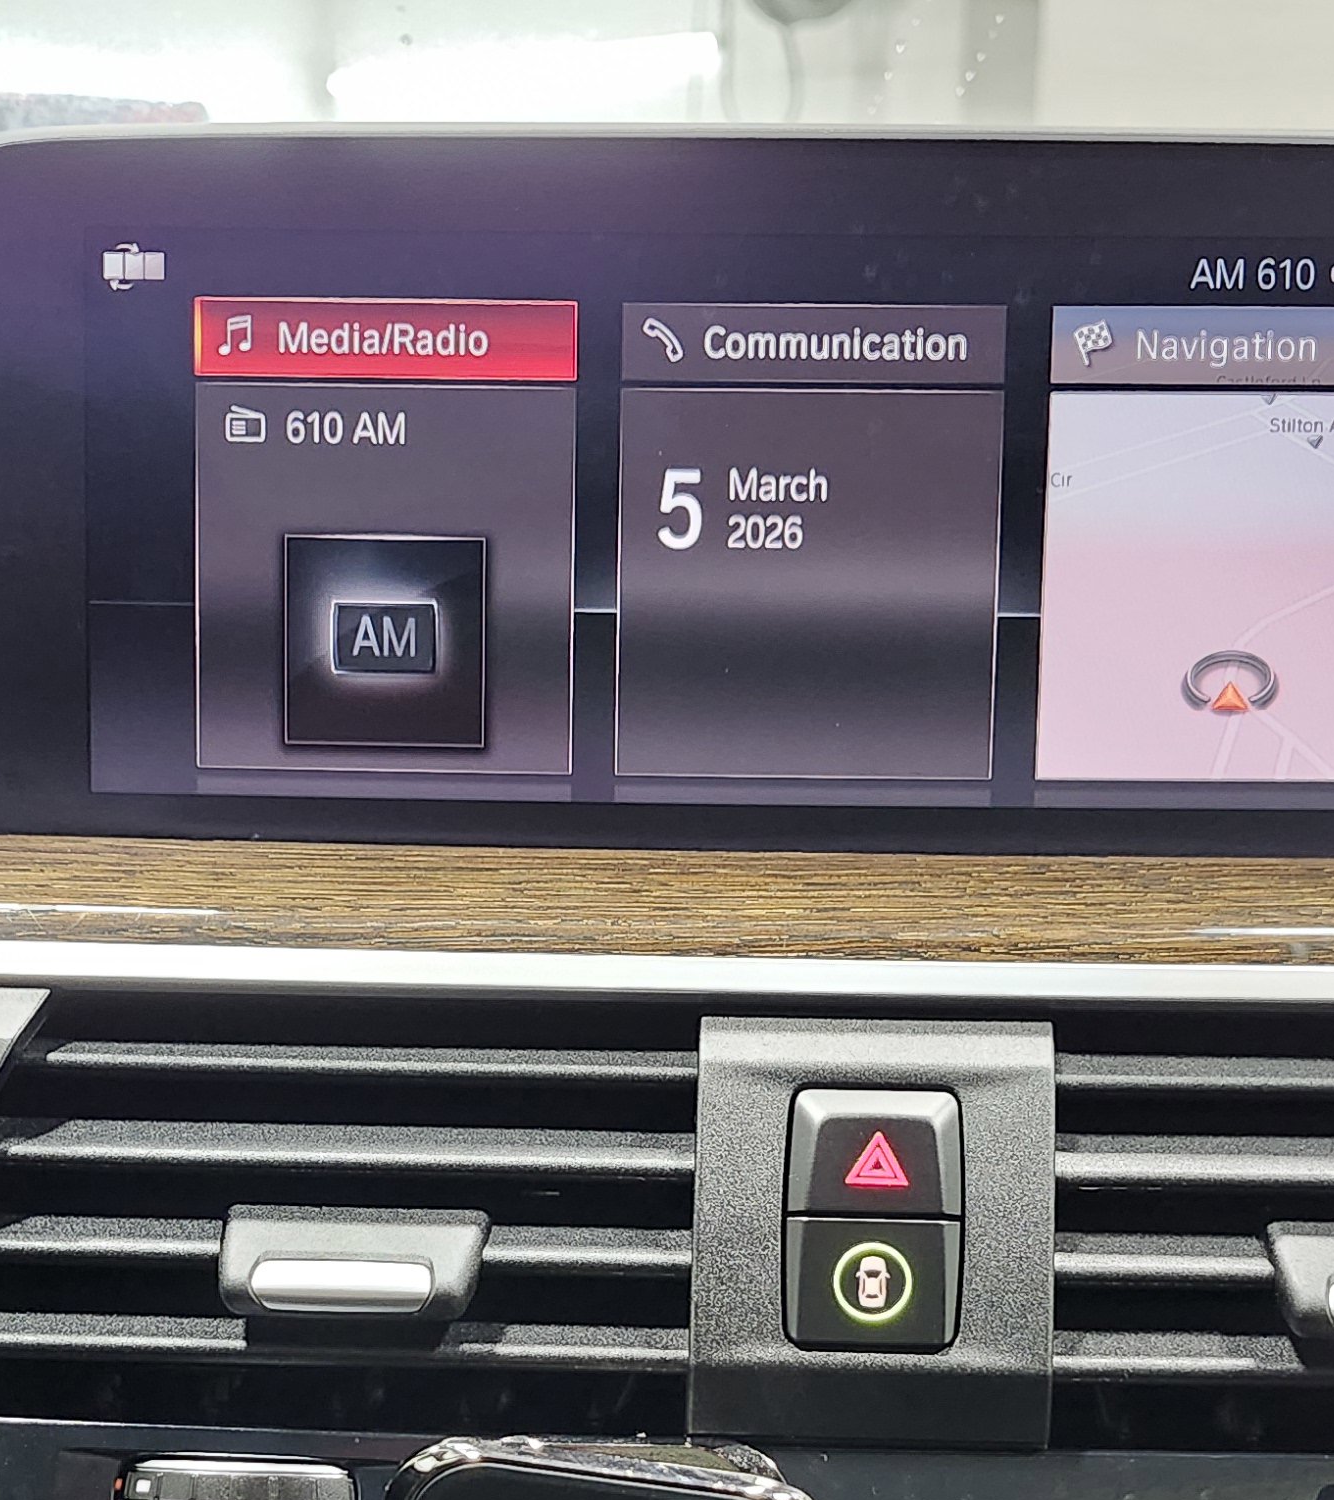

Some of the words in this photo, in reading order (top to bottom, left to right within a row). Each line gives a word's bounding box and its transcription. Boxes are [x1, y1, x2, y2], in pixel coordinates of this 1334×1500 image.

[1190, 259, 1246, 291] AM
[1257, 258, 1316, 290] 610
[277, 320, 489, 357] Media/Radio
[703, 324, 968, 364] Communication
[1135, 328, 1318, 368] Navigation
[285, 411, 343, 446] 610
[352, 411, 407, 446] AM
[1269, 417, 1323, 433] Stilton
[657, 467, 703, 549] 5
[728, 467, 828, 503] March
[727, 514, 804, 549] 2026
[351, 616, 417, 659] AM
